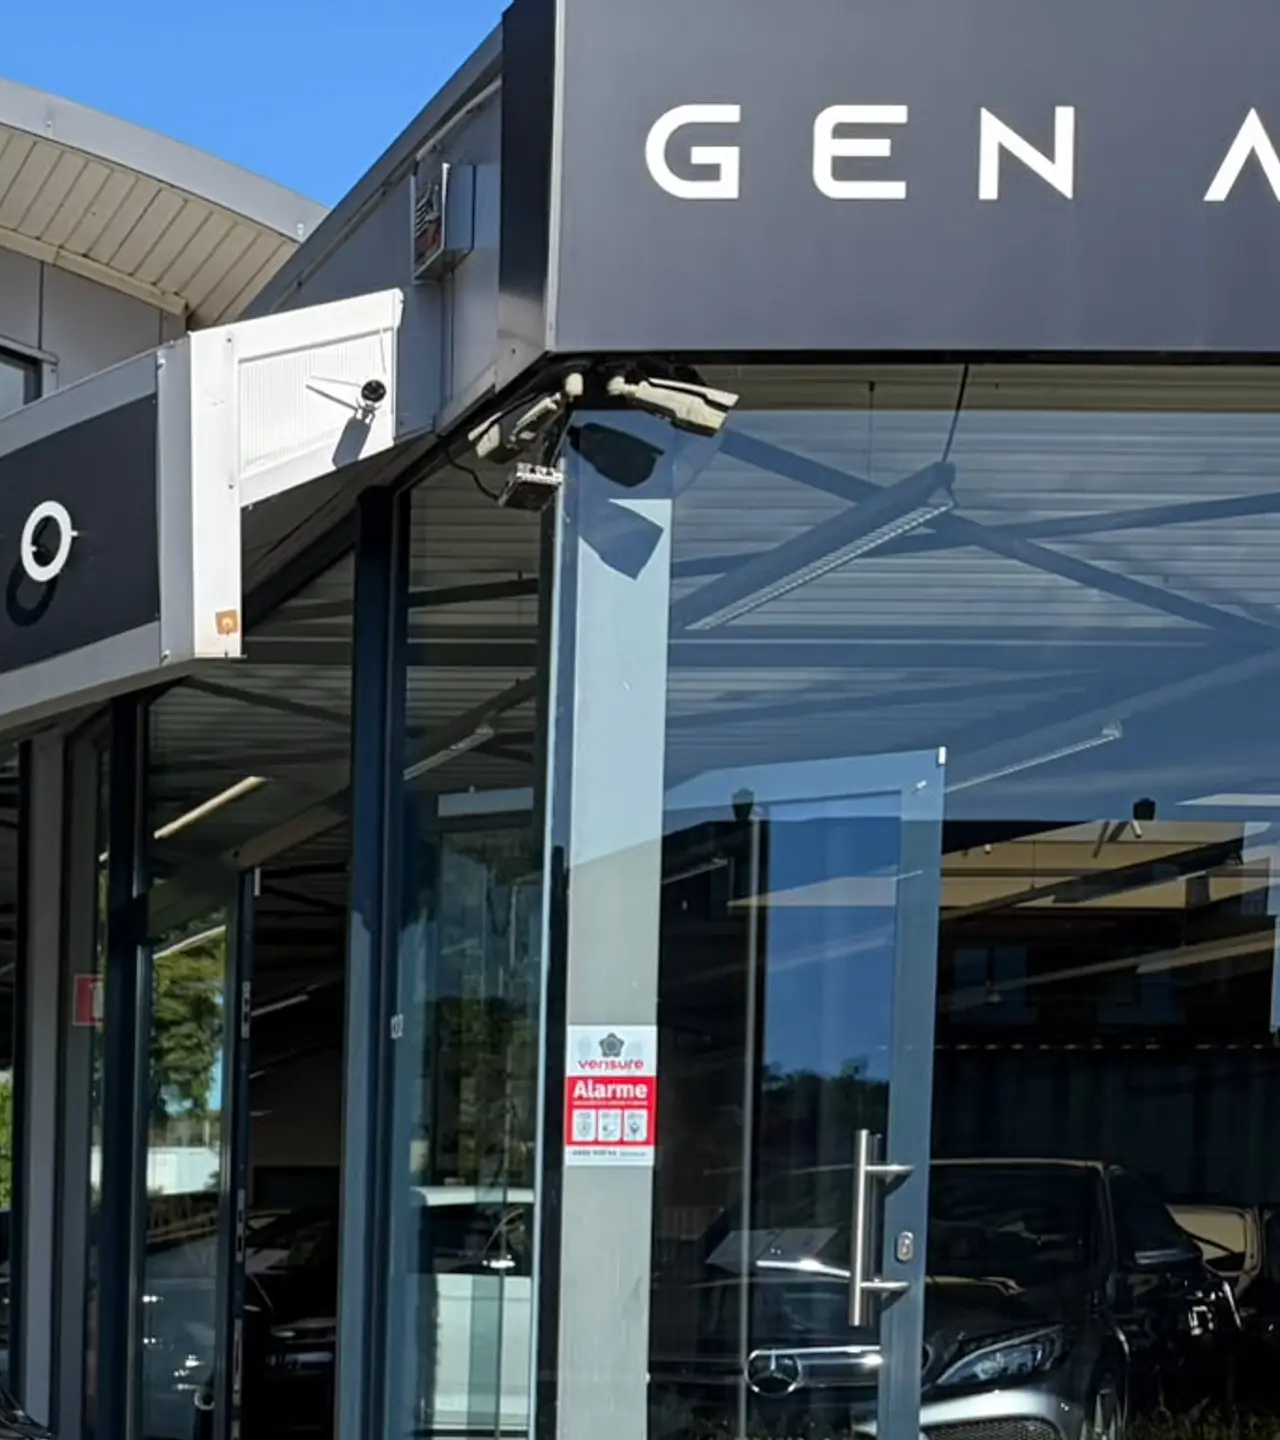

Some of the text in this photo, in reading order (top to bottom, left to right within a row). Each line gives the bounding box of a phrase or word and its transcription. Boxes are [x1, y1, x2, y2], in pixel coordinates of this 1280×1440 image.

[645, 104, 1075, 200] GEN
[577, 1058, 644, 1071] verisure
[573, 1078, 648, 1099] Alarme
